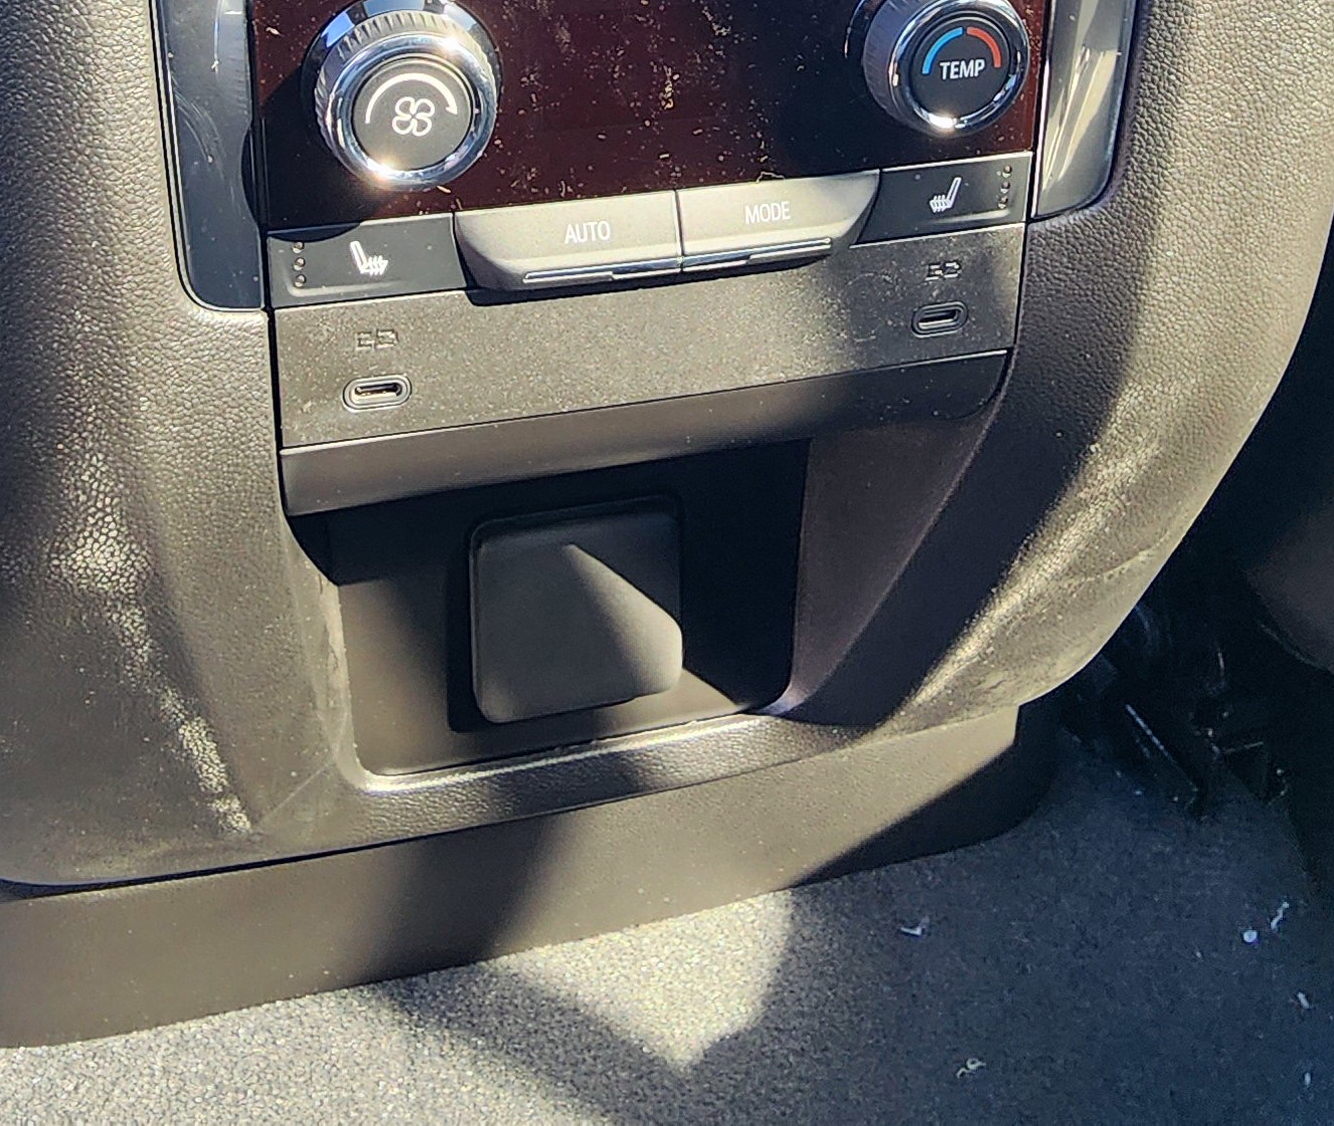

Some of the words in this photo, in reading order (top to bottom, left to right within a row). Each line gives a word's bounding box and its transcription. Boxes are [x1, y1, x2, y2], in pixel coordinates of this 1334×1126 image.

[939, 58, 986, 80] TEMP
[744, 201, 791, 224] MODE
[563, 220, 612, 244] AUTO
